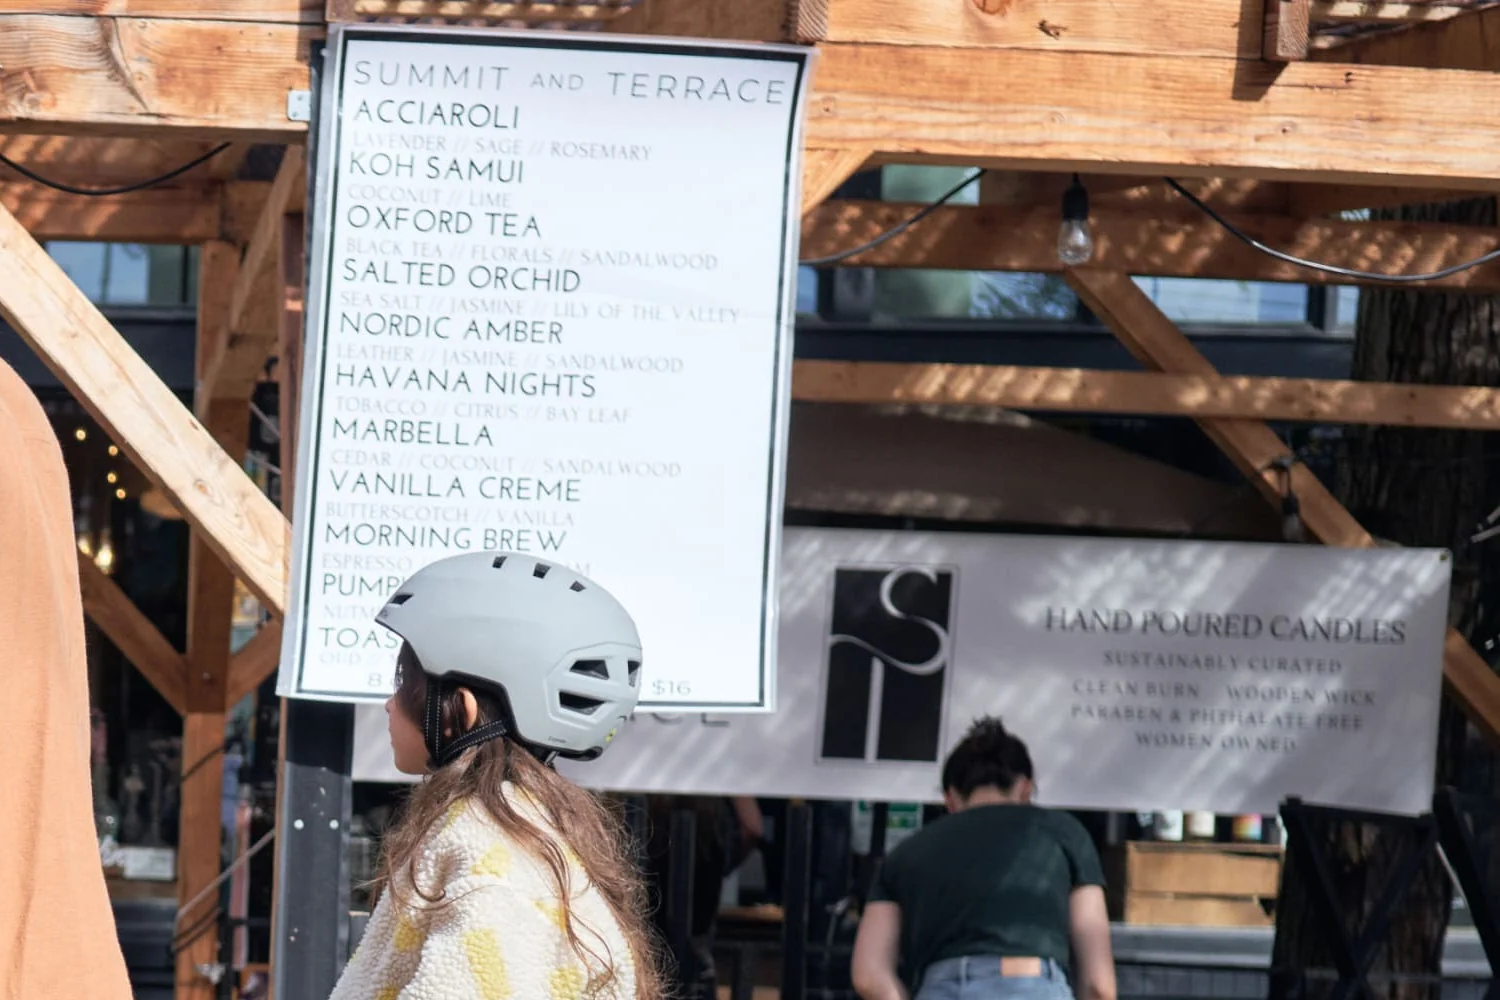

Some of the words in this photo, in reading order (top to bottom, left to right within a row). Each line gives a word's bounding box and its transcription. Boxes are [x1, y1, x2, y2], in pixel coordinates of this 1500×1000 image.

[354, 60, 509, 90] SUMMIT
[530, 73, 584, 91] AND
[607, 72, 785, 104] TERRACE
[353, 100, 519, 129] ACCIAROLI
[353, 131, 446, 151] LAVENDER
[475, 137, 523, 155] SAGE
[550, 141, 651, 161] ROSEMARY
[349, 151, 415, 178] KOH
[426, 156, 523, 183] SAMUI
[348, 184, 442, 204] COCONUT
[469, 189, 512, 208] LIME
[347, 205, 473, 234] OXFORD
[484, 212, 541, 239] TEA
[346, 237, 403, 256] BLACK
[412, 241, 442, 257] TEA
[471, 244, 552, 263] FLORALS
[581, 249, 718, 270] SANDALWOOD
[343, 257, 455, 287] SALTED
[468, 265, 581, 293] ORCHID
[341, 291, 372, 306] SEA
[380, 294, 422, 310] SALT
[449, 297, 524, 315] JASMINE
[554, 301, 588, 318] LILY
[598, 303, 621, 319] OF
[633, 304, 664, 321] THE
[673, 305, 739, 323] VALLEY
[340, 312, 451, 339] NORDIC
[463, 318, 563, 344] AMBER
[336, 344, 413, 362] LEATHER
[443, 348, 516, 366] JASMINE
[546, 353, 684, 373] SANDALWOOD
[336, 363, 472, 393] HAVANA
[485, 371, 596, 398] NIGHTS
[336, 396, 427, 416] TOBACCO
[454, 402, 518, 419] CITRUS
[546, 406, 578, 422] BAY
[588, 407, 633, 424] LEAF
[332, 416, 494, 447] MARBELLA
[331, 449, 391, 466] CEDAR
[420, 453, 515, 472] COCONUT
[543, 457, 682, 478] SANDALWOOD
[329, 468, 466, 498] VANILLA
[478, 476, 580, 502] CREME
[326, 501, 468, 522] BUTTERSCOTCH
[497, 508, 574, 527] VANILLA
[325, 522, 471, 550] MORNING
[483, 528, 567, 552] BREW
[322, 552, 412, 571] ESPRESSO
[322, 572, 404, 597] PUMP
[319, 626, 400, 649] TOAS
[1046, 605, 1133, 635] HAND
[1141, 609, 1262, 640] POURED
[1269, 613, 1406, 646] CANDLES
[1103, 650, 1239, 671] SUSTAINABLY
[1247, 655, 1342, 674] CURATED
[652, 679, 691, 697] $16
[1072, 677, 1138, 697] CLEAN
[1146, 680, 1199, 698] BURN
[1226, 684, 1316, 704] WOODEN
[1324, 688, 1376, 706] WICK
[1070, 702, 1163, 723] PARABEN
[1135, 730, 1213, 750] WOMEN
[1220, 734, 1296, 753] OWNED
